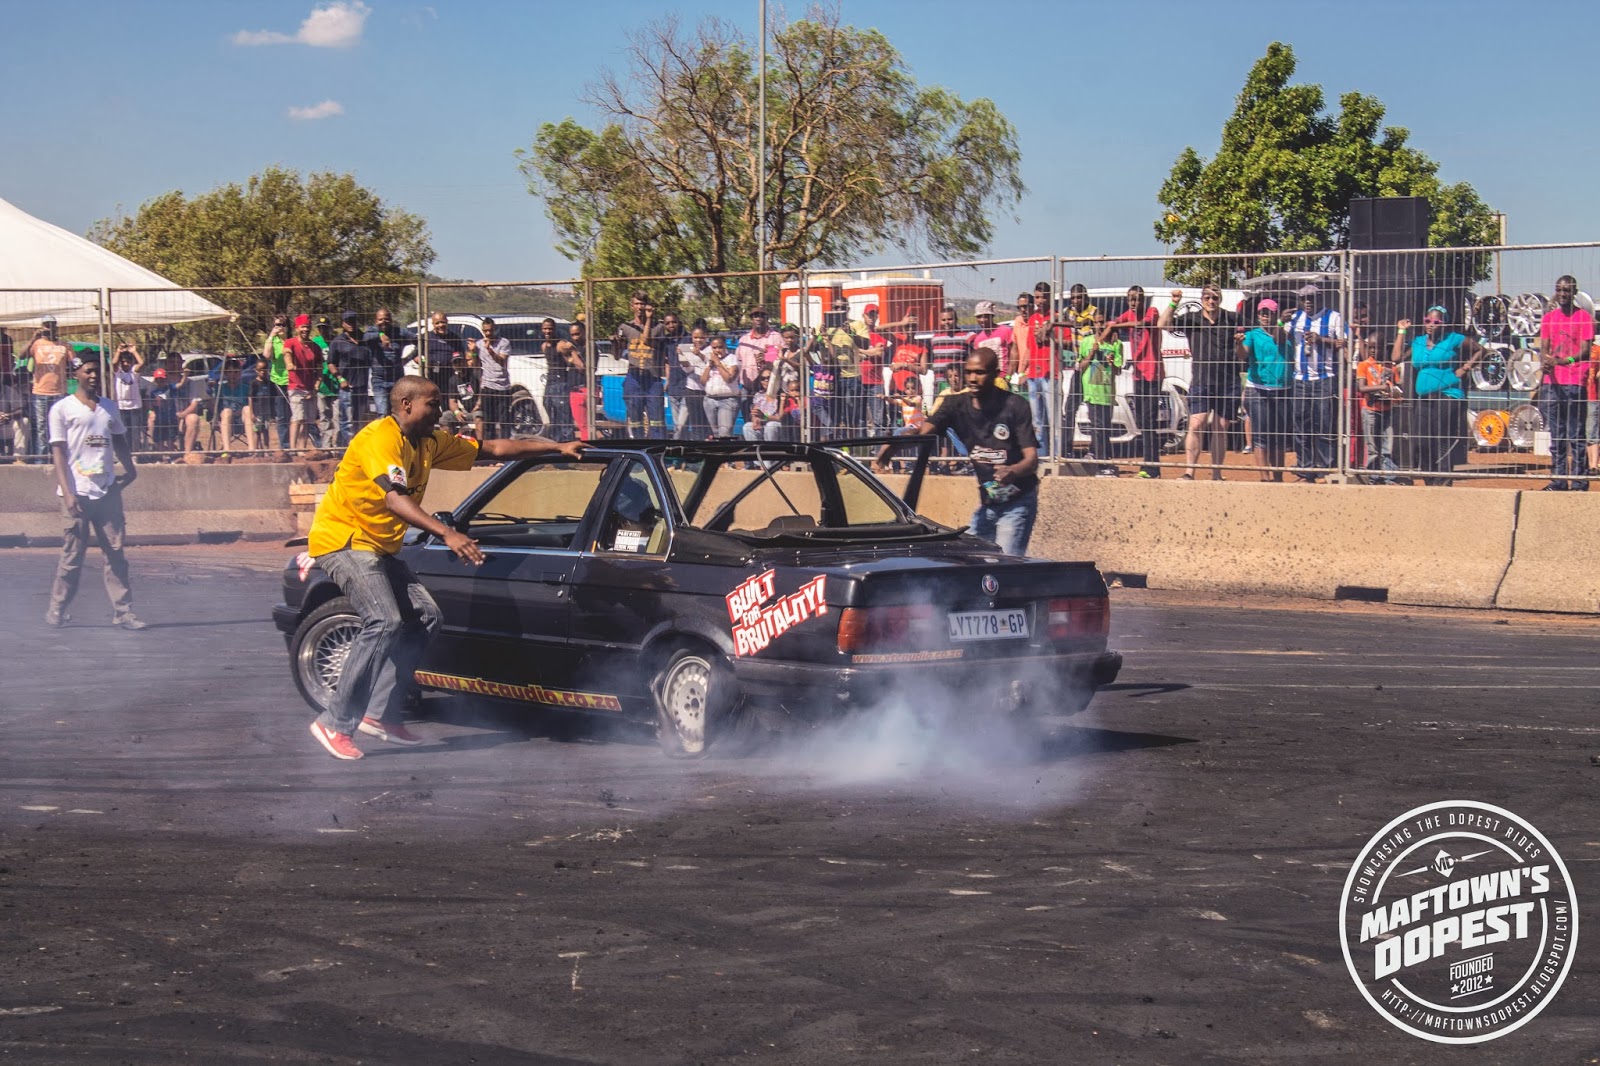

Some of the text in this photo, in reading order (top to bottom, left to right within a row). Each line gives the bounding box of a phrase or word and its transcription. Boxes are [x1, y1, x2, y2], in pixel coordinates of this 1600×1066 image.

[728, 570, 775, 621] BUILT
[734, 577, 827, 656] BRUTALITY!
[742, 605, 761, 628] FOR
[1008, 613, 1025, 634] GP
[415, 671, 621, 711] www.xtcaudio.co.za
